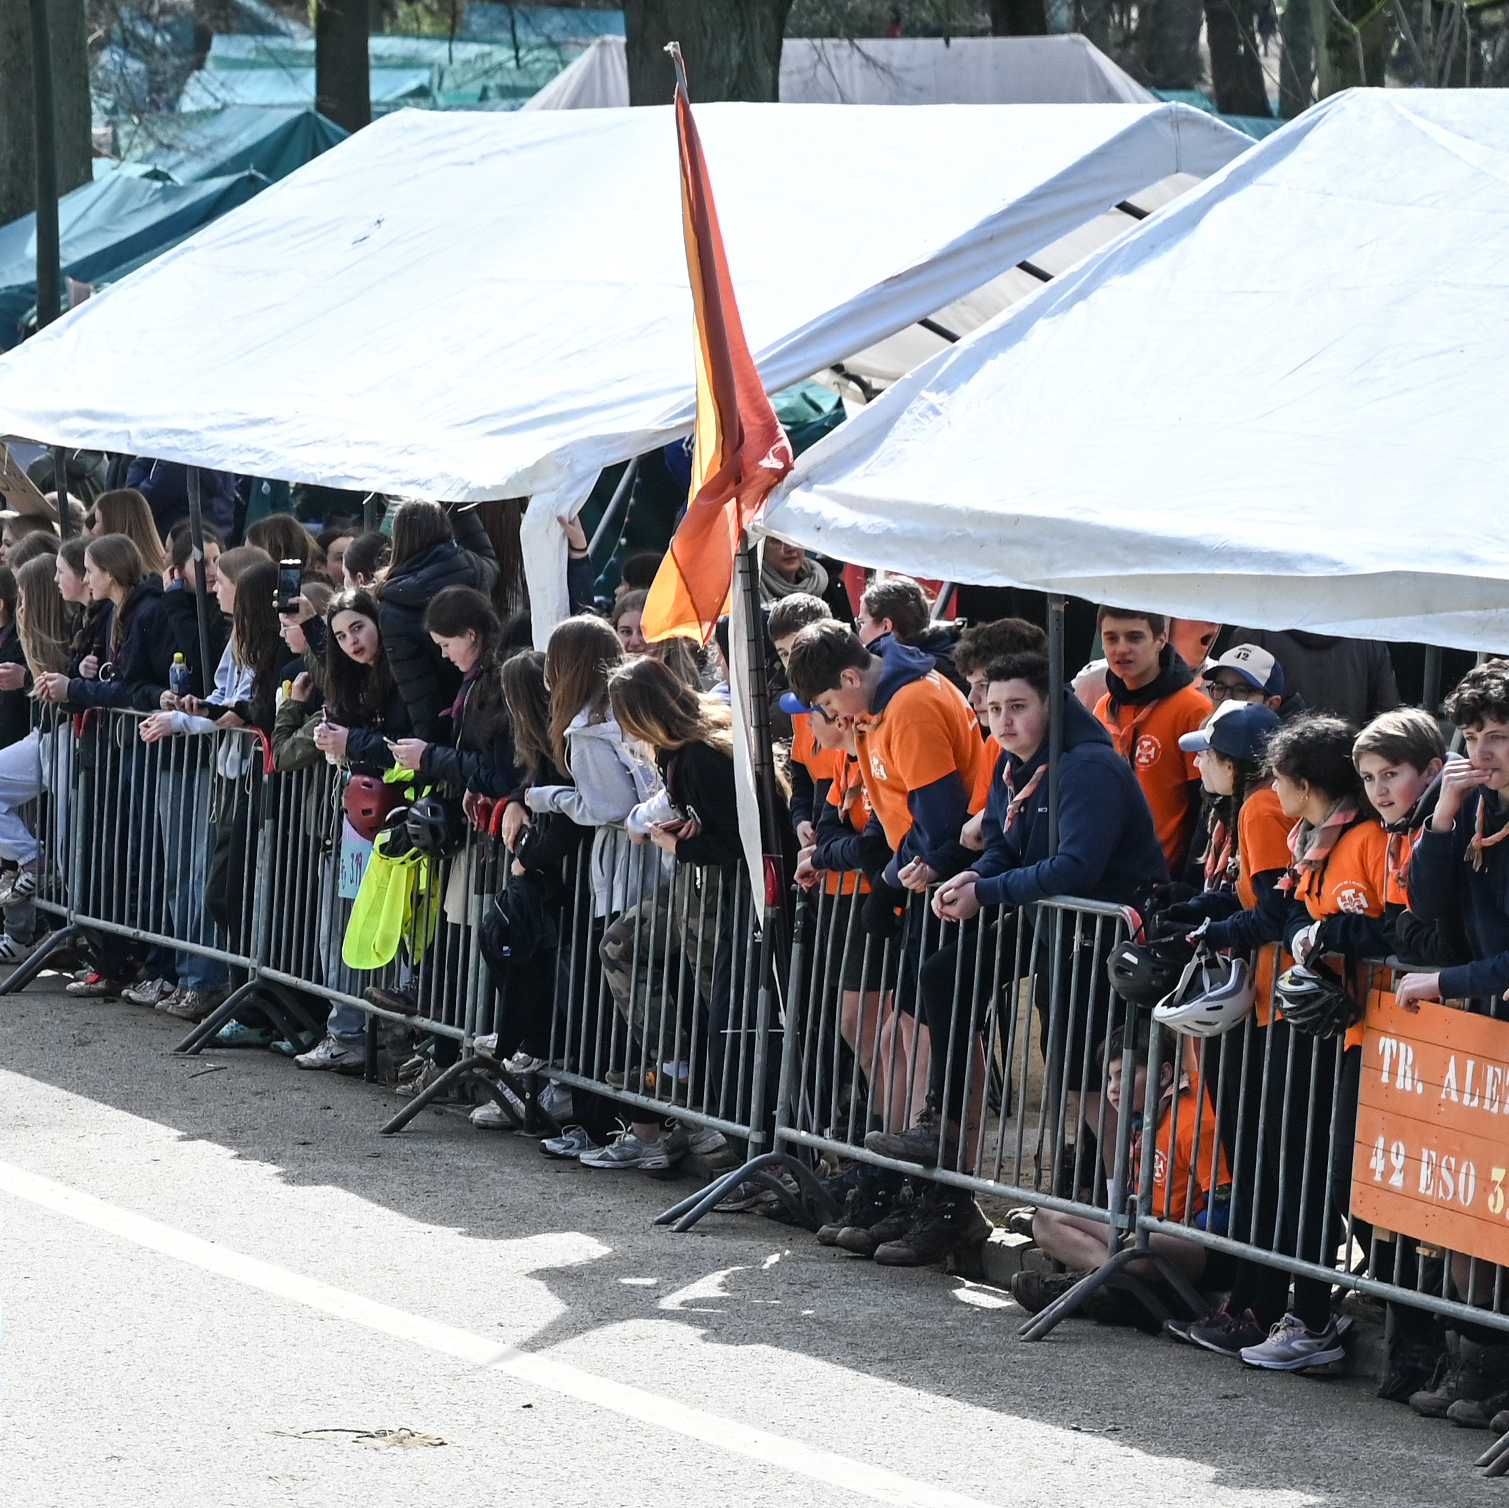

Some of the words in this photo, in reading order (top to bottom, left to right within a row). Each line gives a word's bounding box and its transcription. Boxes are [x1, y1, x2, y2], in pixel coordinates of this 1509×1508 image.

[1378, 1036, 1424, 1095] TR.
[1369, 1136, 1406, 1188] 42
[1418, 1148, 1476, 1207] ESO
